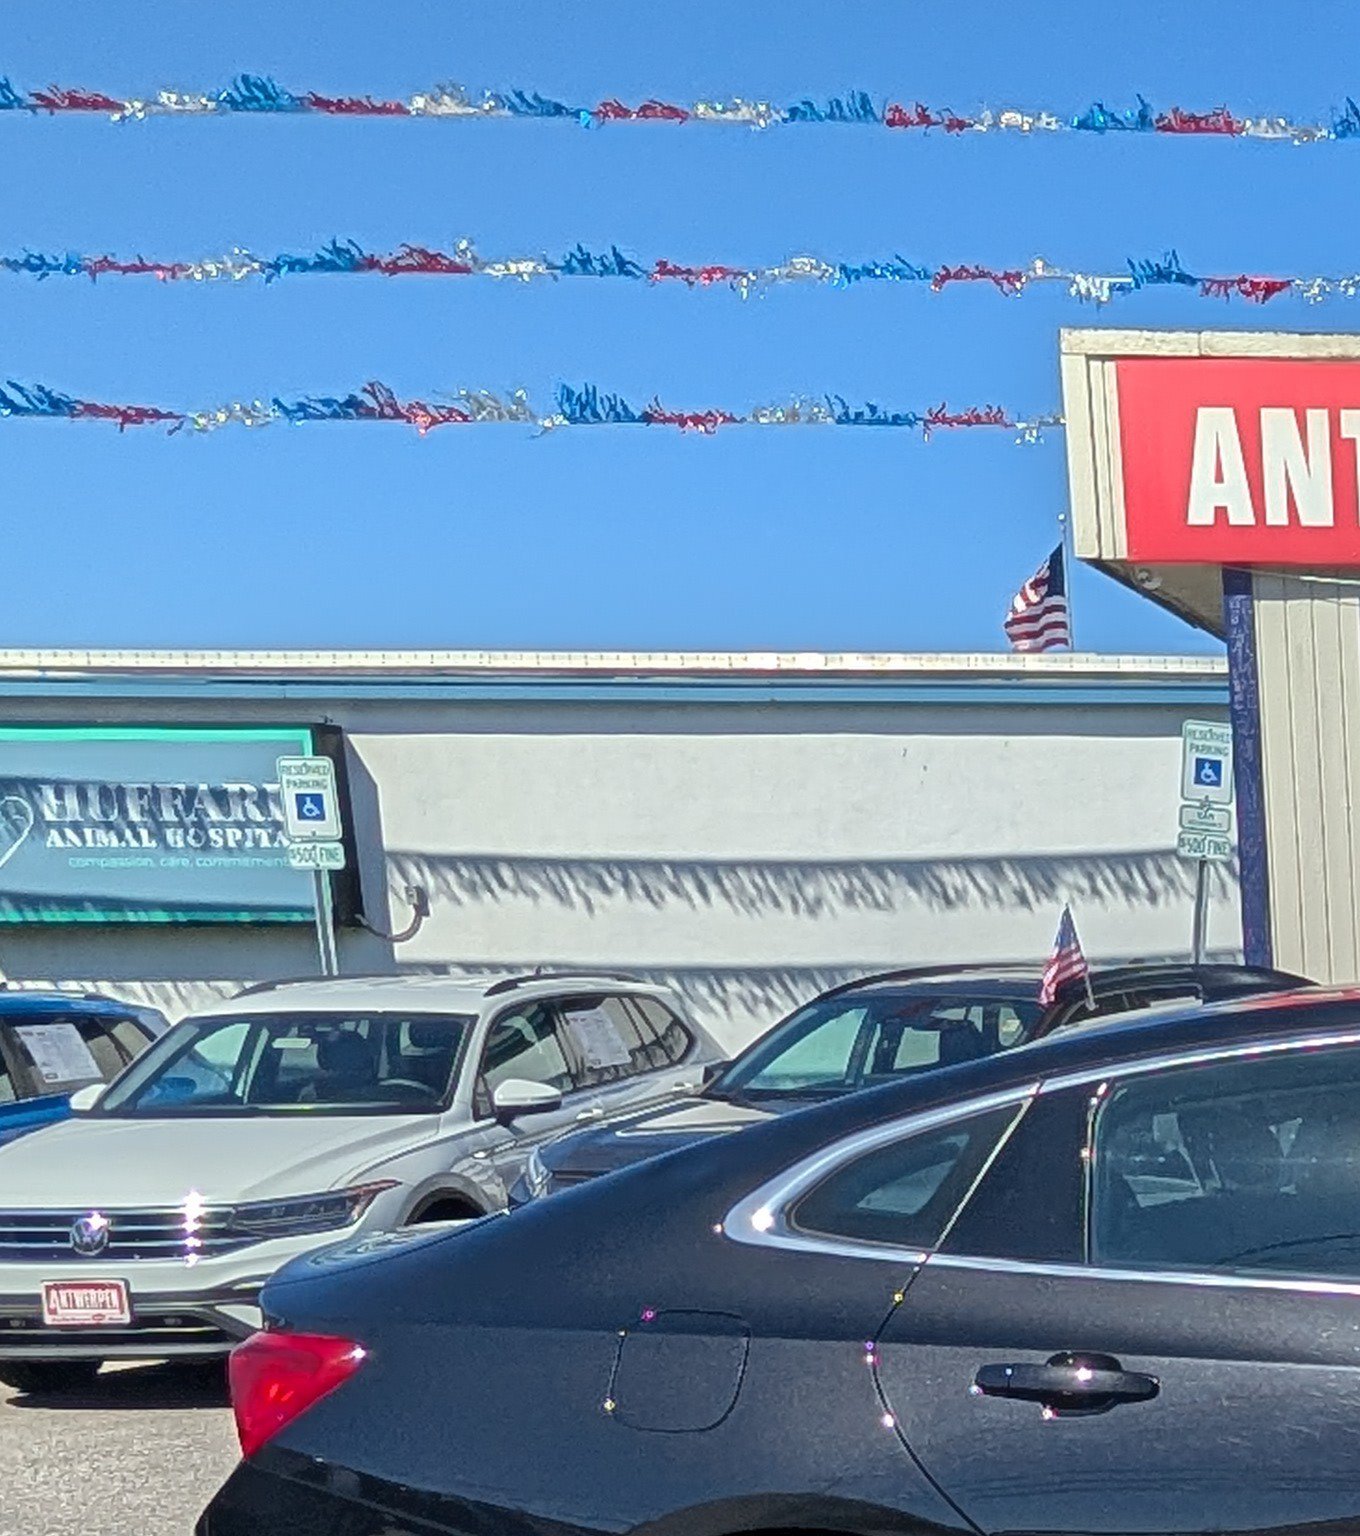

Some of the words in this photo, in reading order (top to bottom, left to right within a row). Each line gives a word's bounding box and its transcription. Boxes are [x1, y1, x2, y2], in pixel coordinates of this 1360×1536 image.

[1189, 743, 1229, 757] PARKING
[286, 778, 328, 790] PARKING
[45, 827, 159, 849] ANIMAL
[165, 827, 291, 849] HOSPITA
[319, 846, 342, 863] FINE
